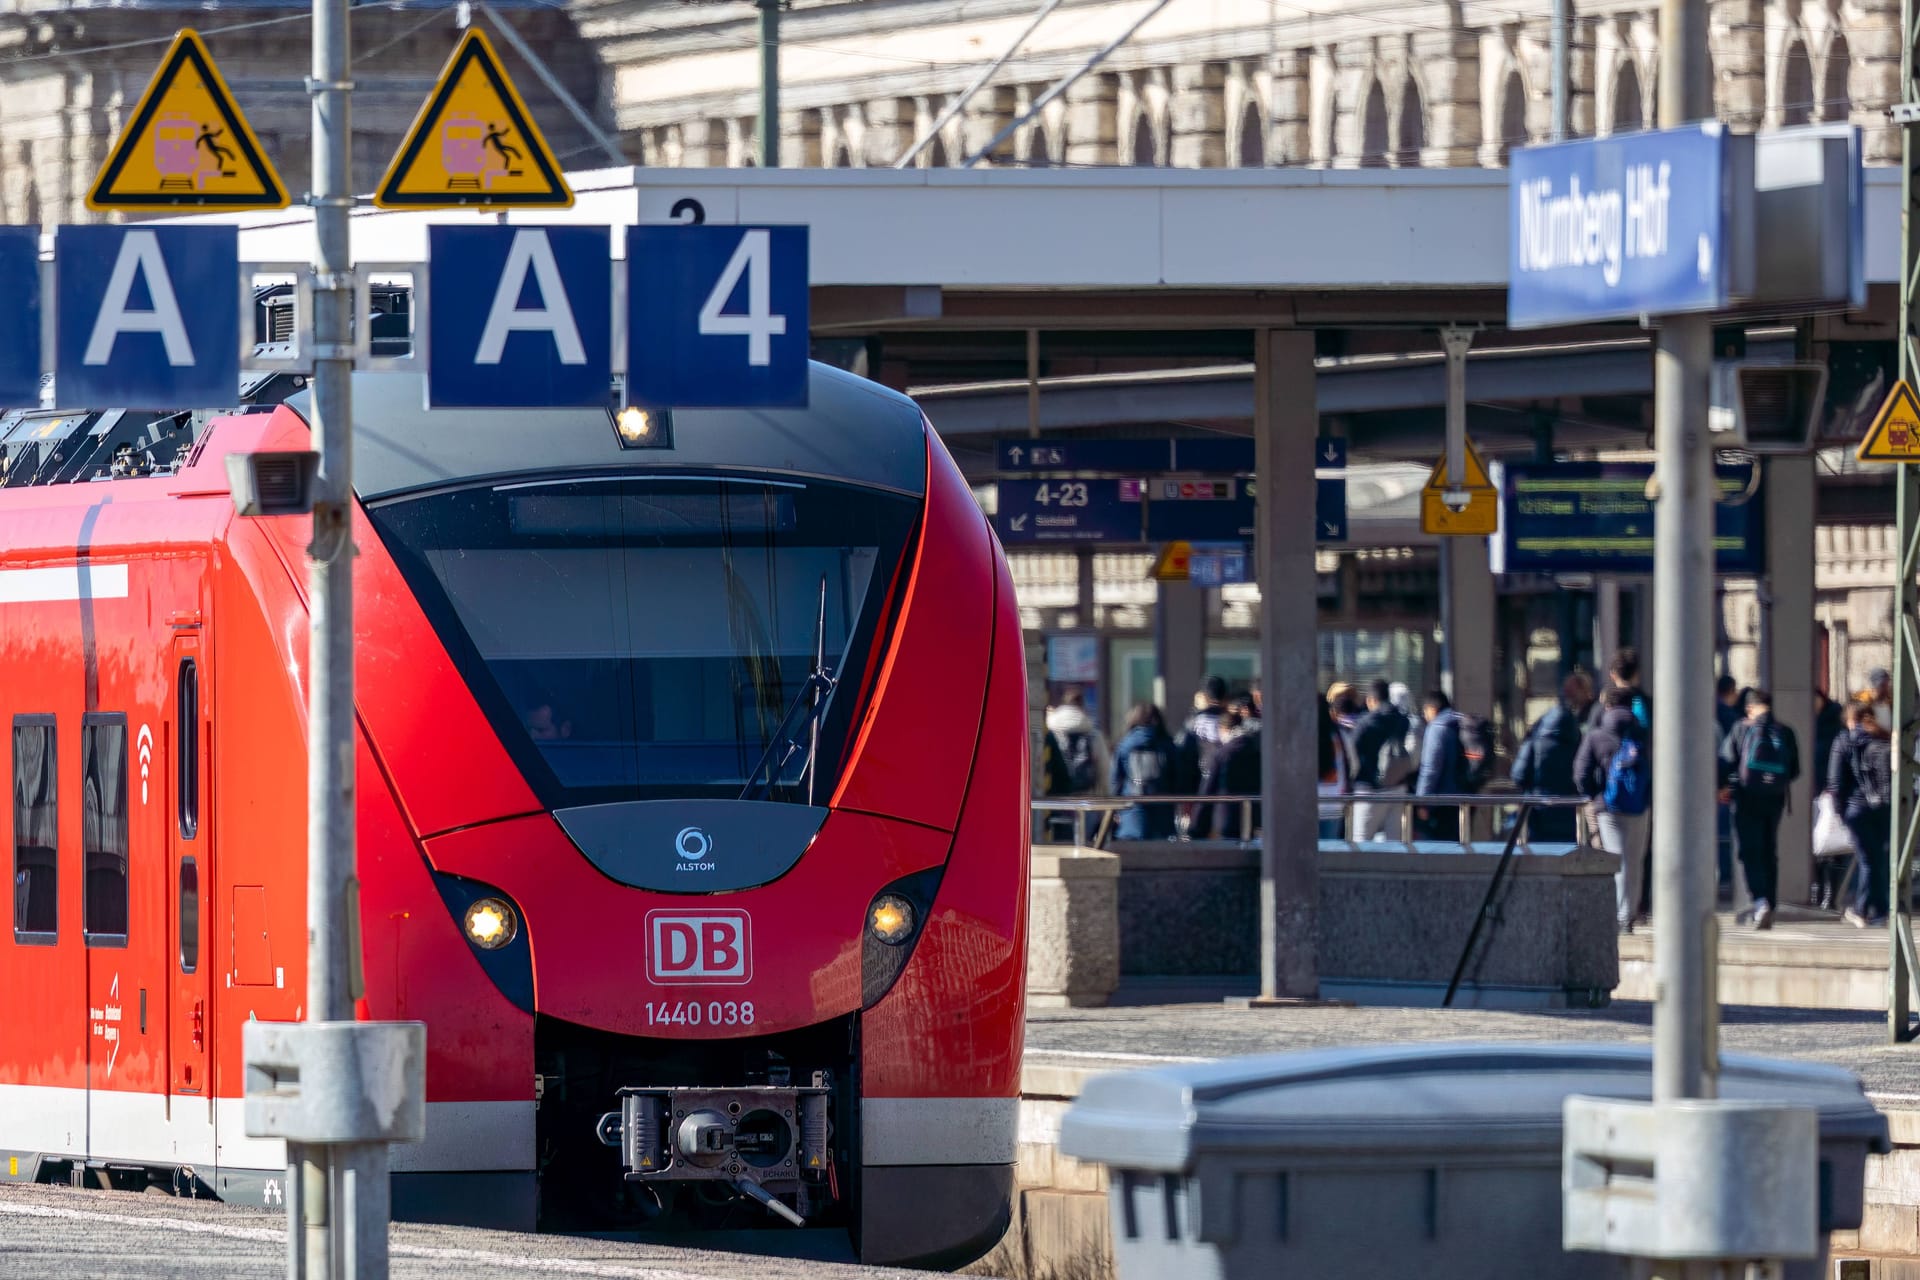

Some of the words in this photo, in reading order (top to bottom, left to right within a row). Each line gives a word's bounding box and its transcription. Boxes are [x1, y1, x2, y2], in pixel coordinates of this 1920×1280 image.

[1519, 173, 1622, 287] Nürnberg
[1626, 160, 1670, 258] Hbf
[82, 230, 196, 367] A
[474, 228, 588, 365] A
[698, 228, 787, 367] 4
[1035, 482, 1089, 507] 4-23
[675, 862, 716, 871] ALSTOM
[659, 921, 739, 972] DB
[645, 1002, 702, 1026] 1440
[708, 1002, 755, 1026] 038
